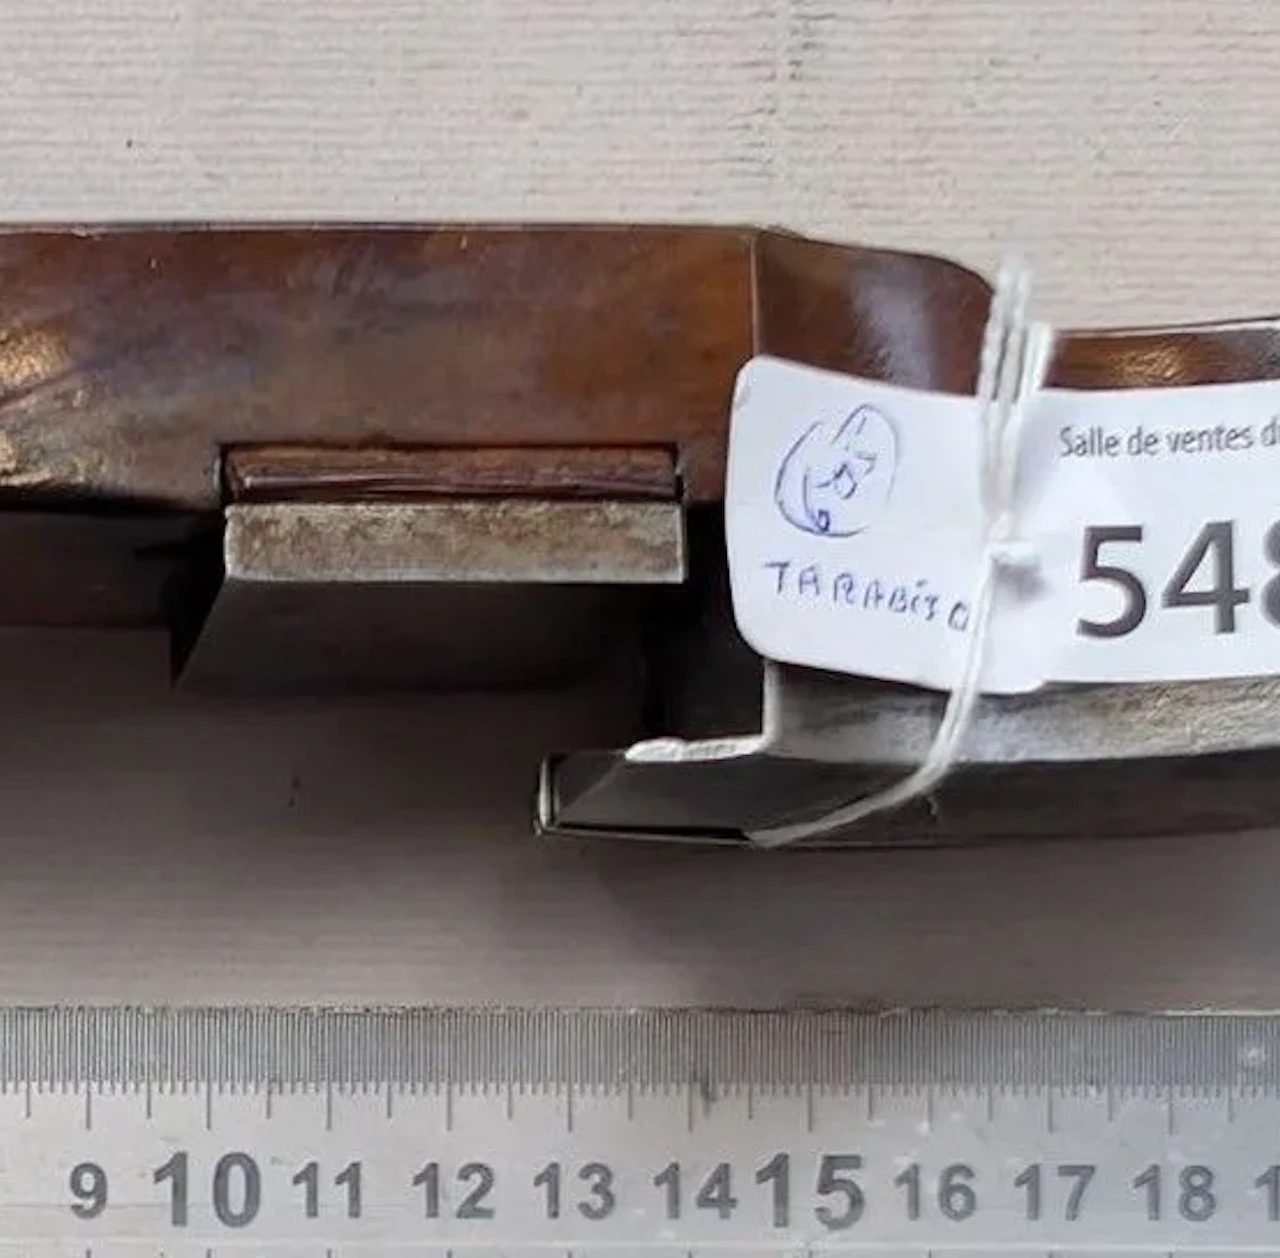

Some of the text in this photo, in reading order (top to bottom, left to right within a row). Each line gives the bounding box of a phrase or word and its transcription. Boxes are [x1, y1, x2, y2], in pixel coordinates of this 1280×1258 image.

[1059, 424, 1122, 458] Salle
[1126, 425, 1163, 457] de
[1166, 424, 1256, 454] ventes
[68, 1161, 109, 1221] 9
[152, 1150, 262, 1229] 10
[292, 1161, 362, 1220] 11
[411, 1161, 495, 1220] 12
[533, 1161, 617, 1221] 13
[653, 1162, 739, 1220] 14
[755, 1153, 866, 1231] 15
[894, 1163, 977, 1222] 16
[1014, 1163, 1096, 1222] 17
[1133, 1164, 1217, 1222] 18
